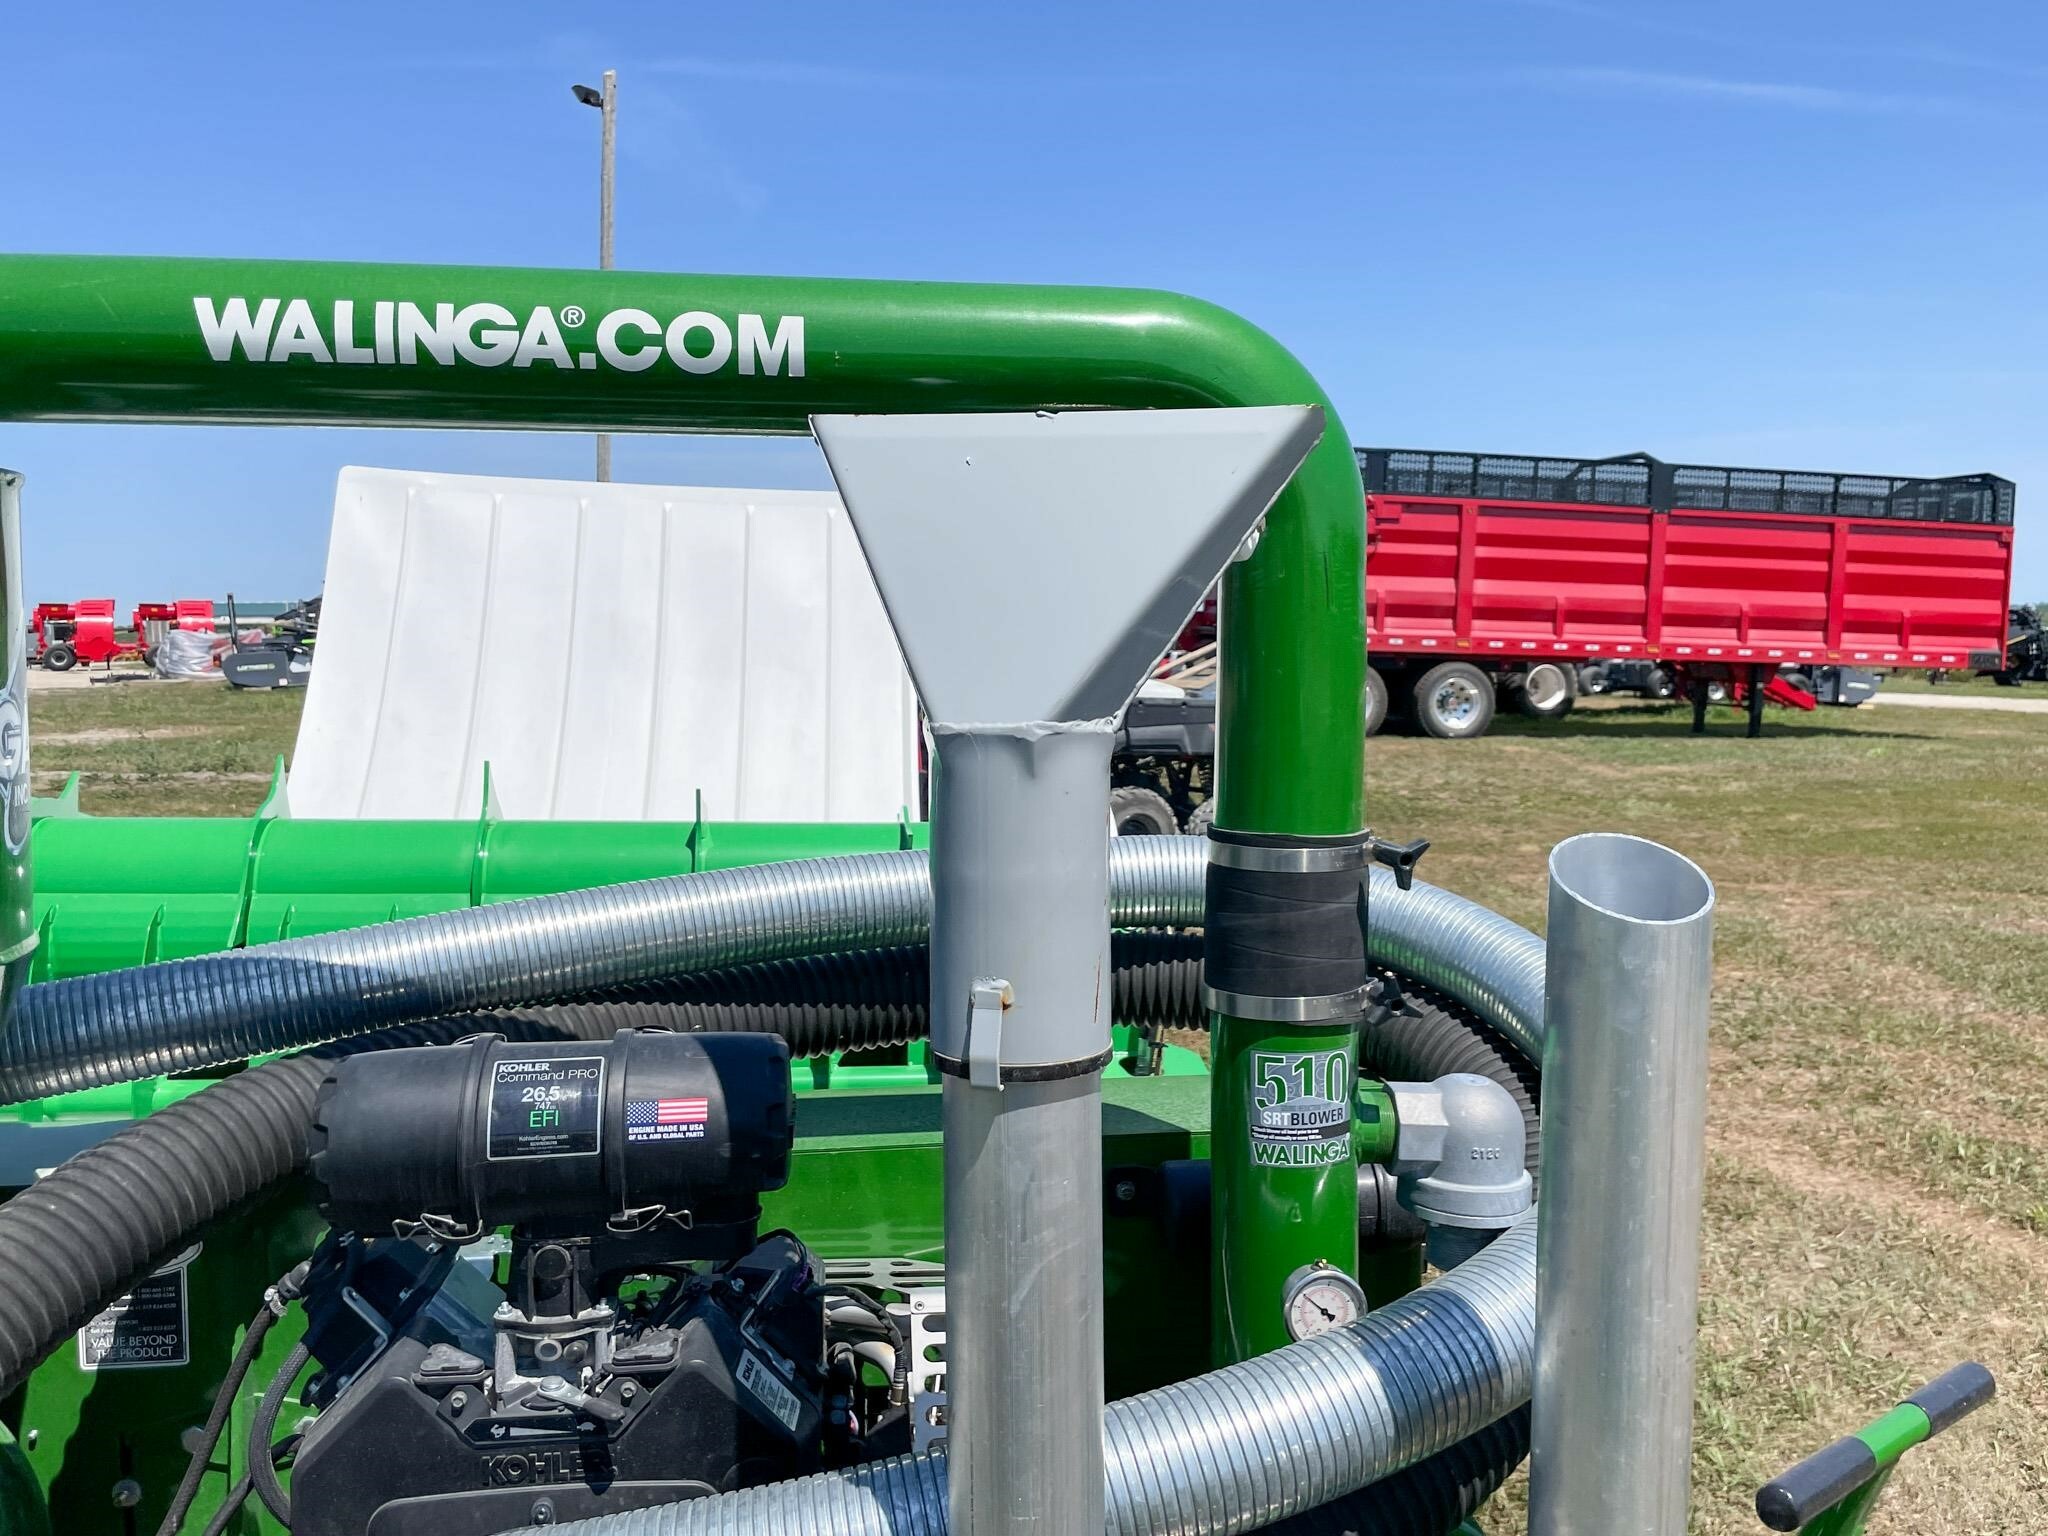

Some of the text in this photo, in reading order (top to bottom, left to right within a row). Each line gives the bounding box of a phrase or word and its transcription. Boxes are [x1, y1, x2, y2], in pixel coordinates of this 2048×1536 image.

[498, 1062, 550, 1073] KOHLER
[497, 1068, 599, 1083] Command PRO
[1255, 1051, 1349, 1110] 510
[521, 1085, 561, 1103] 26.5
[529, 1110, 560, 1128] EFI
[628, 1123, 705, 1134] ENGINE MADE IN USA
[1252, 1139, 1350, 1165] WALINGA
[91, 1334, 177, 1348] VALUE BEYOND
[96, 1346, 173, 1359] THE PRODUCT
